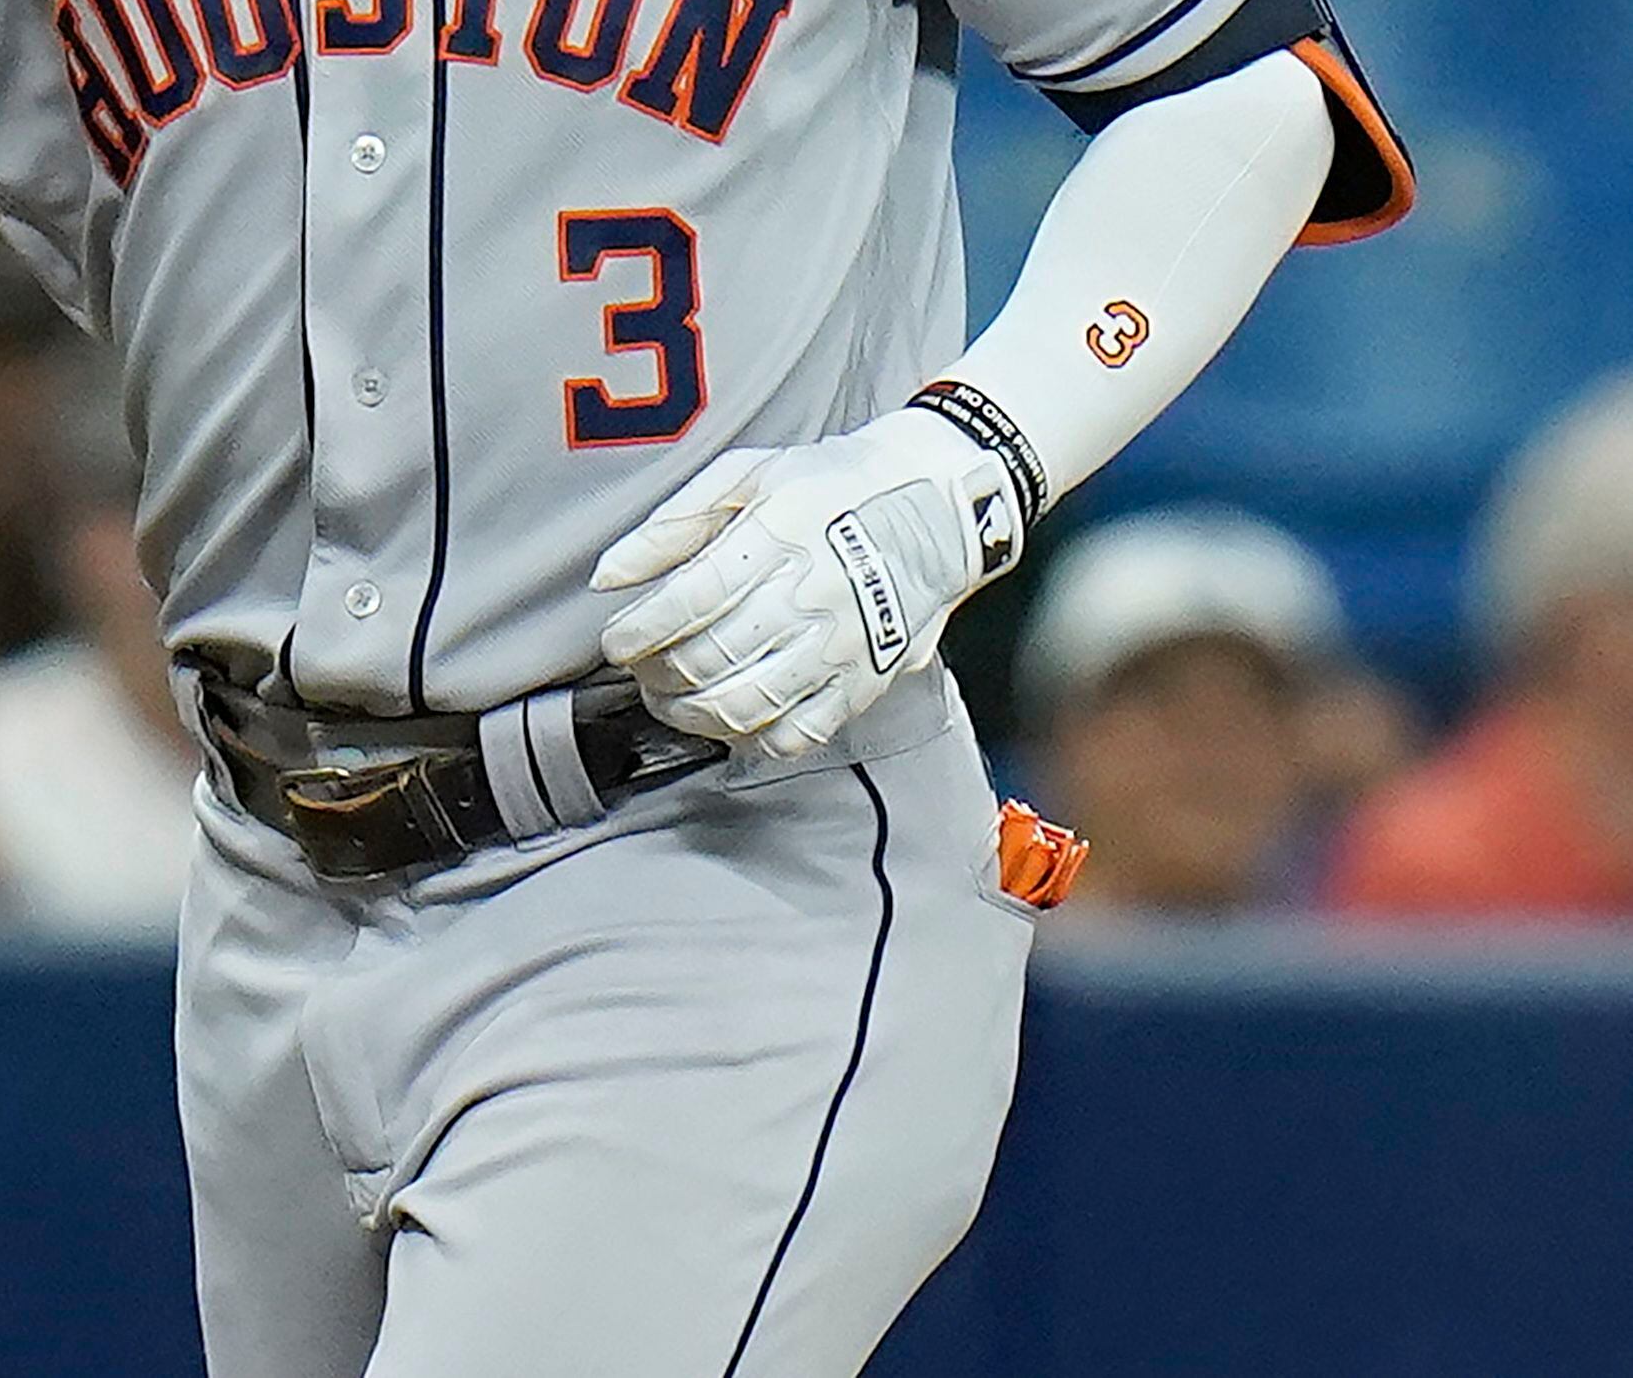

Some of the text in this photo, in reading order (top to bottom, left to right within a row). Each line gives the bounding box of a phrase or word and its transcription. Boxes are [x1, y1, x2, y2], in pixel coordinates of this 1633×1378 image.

[557, 206, 708, 451] 3
[1086, 299, 1150, 369] 3
[953, 385, 984, 409] NO
[981, 403, 1017, 438] ONE
[839, 524, 904, 651] Franklin
